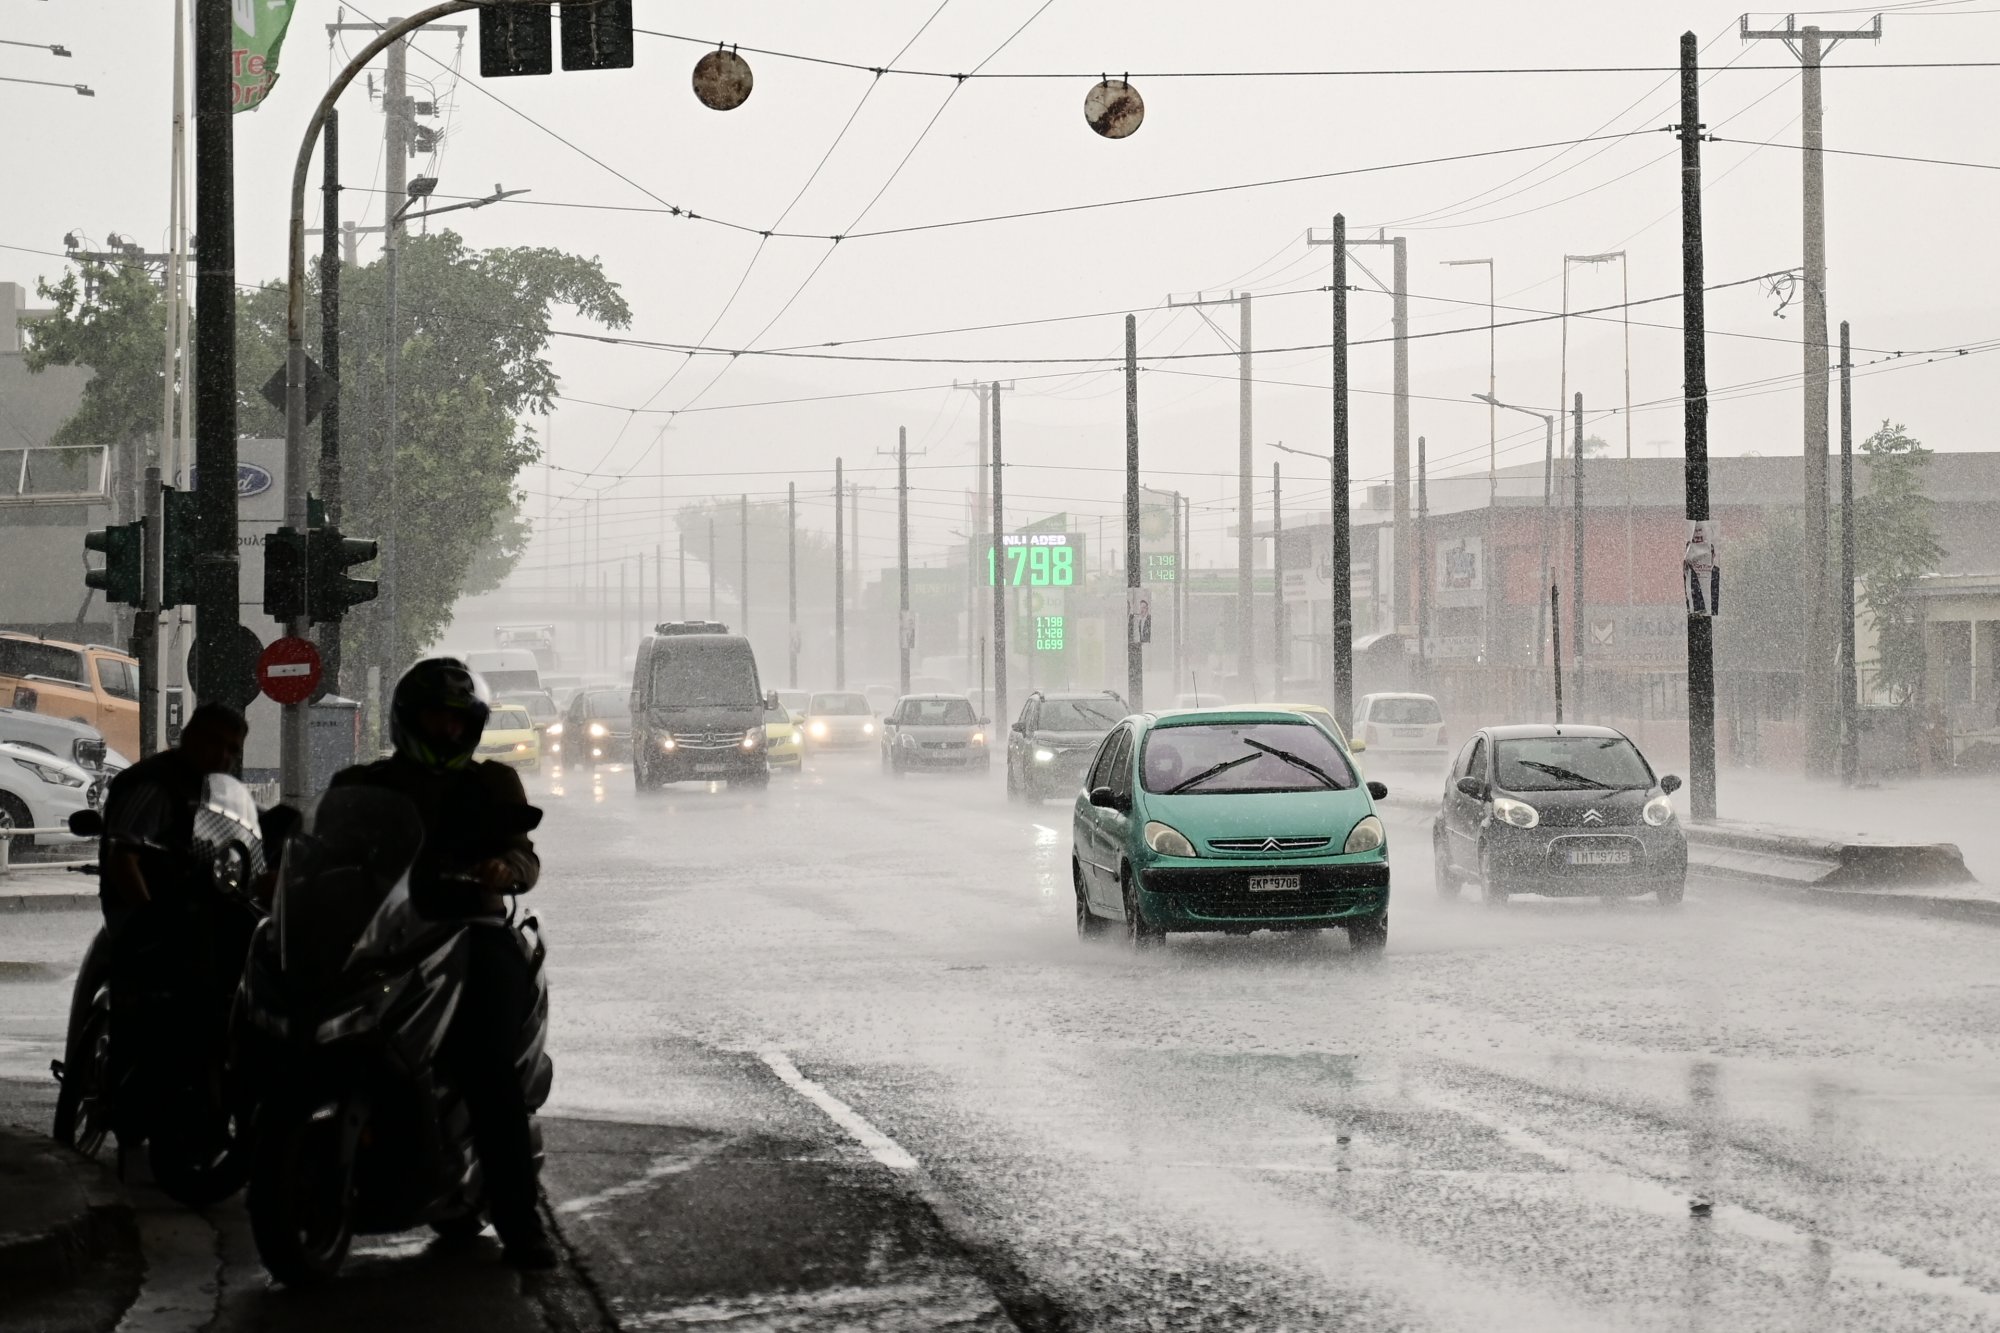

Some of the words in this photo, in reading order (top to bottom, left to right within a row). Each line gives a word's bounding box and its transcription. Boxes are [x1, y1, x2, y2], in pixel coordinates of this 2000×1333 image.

[1036, 616, 1063, 628] 1.798
[1036, 627, 1063, 639] 1.428
[1036, 639, 1063, 650] 0.699
